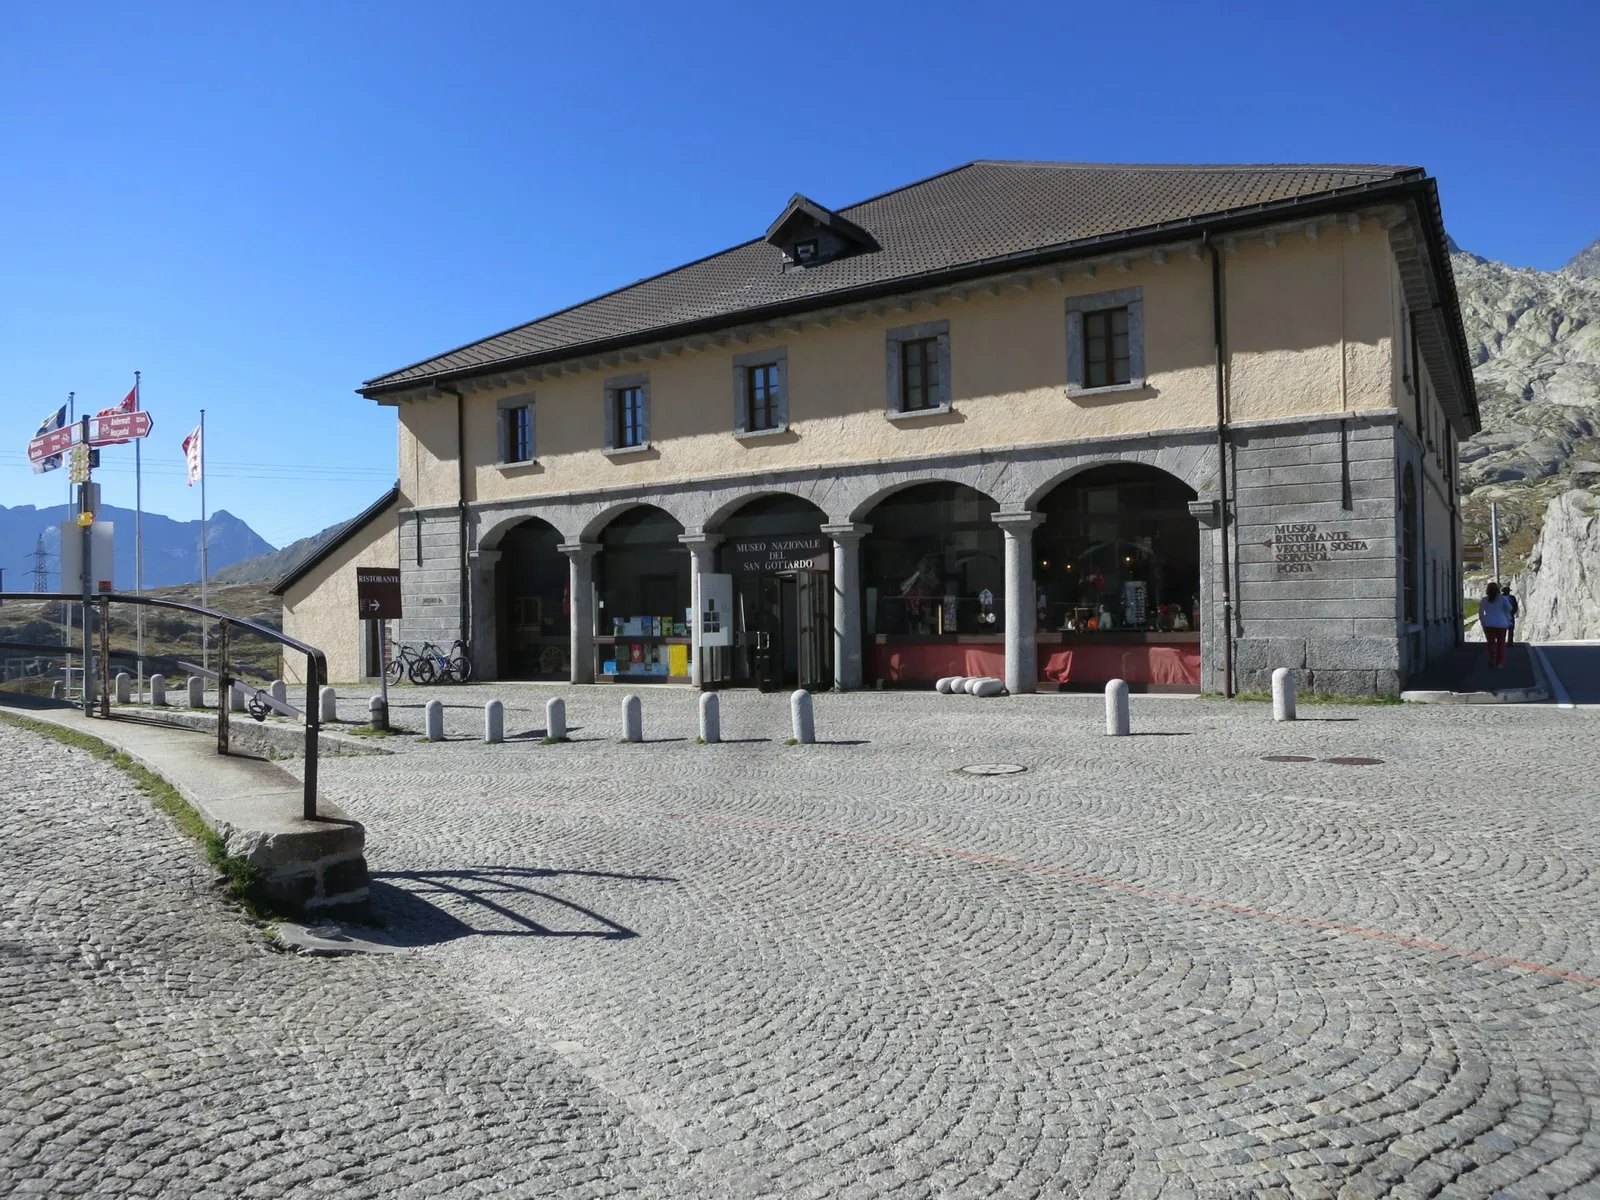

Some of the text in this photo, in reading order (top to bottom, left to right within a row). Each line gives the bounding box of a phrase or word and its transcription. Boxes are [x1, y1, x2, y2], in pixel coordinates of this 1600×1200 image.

[1274, 523, 1317, 534] MUSEO
[1275, 531, 1351, 544] RISTORANTE
[736, 539, 821, 553] MUSEO NAZIONALE
[1276, 541, 1368, 554] VECCHIA SOSTA
[769, 551, 785, 560] DEL
[743, 559, 813, 571] SAN GOTTARDO
[1277, 563, 1313, 574] POSTA
[358, 575, 399, 583] RISTORANTE
